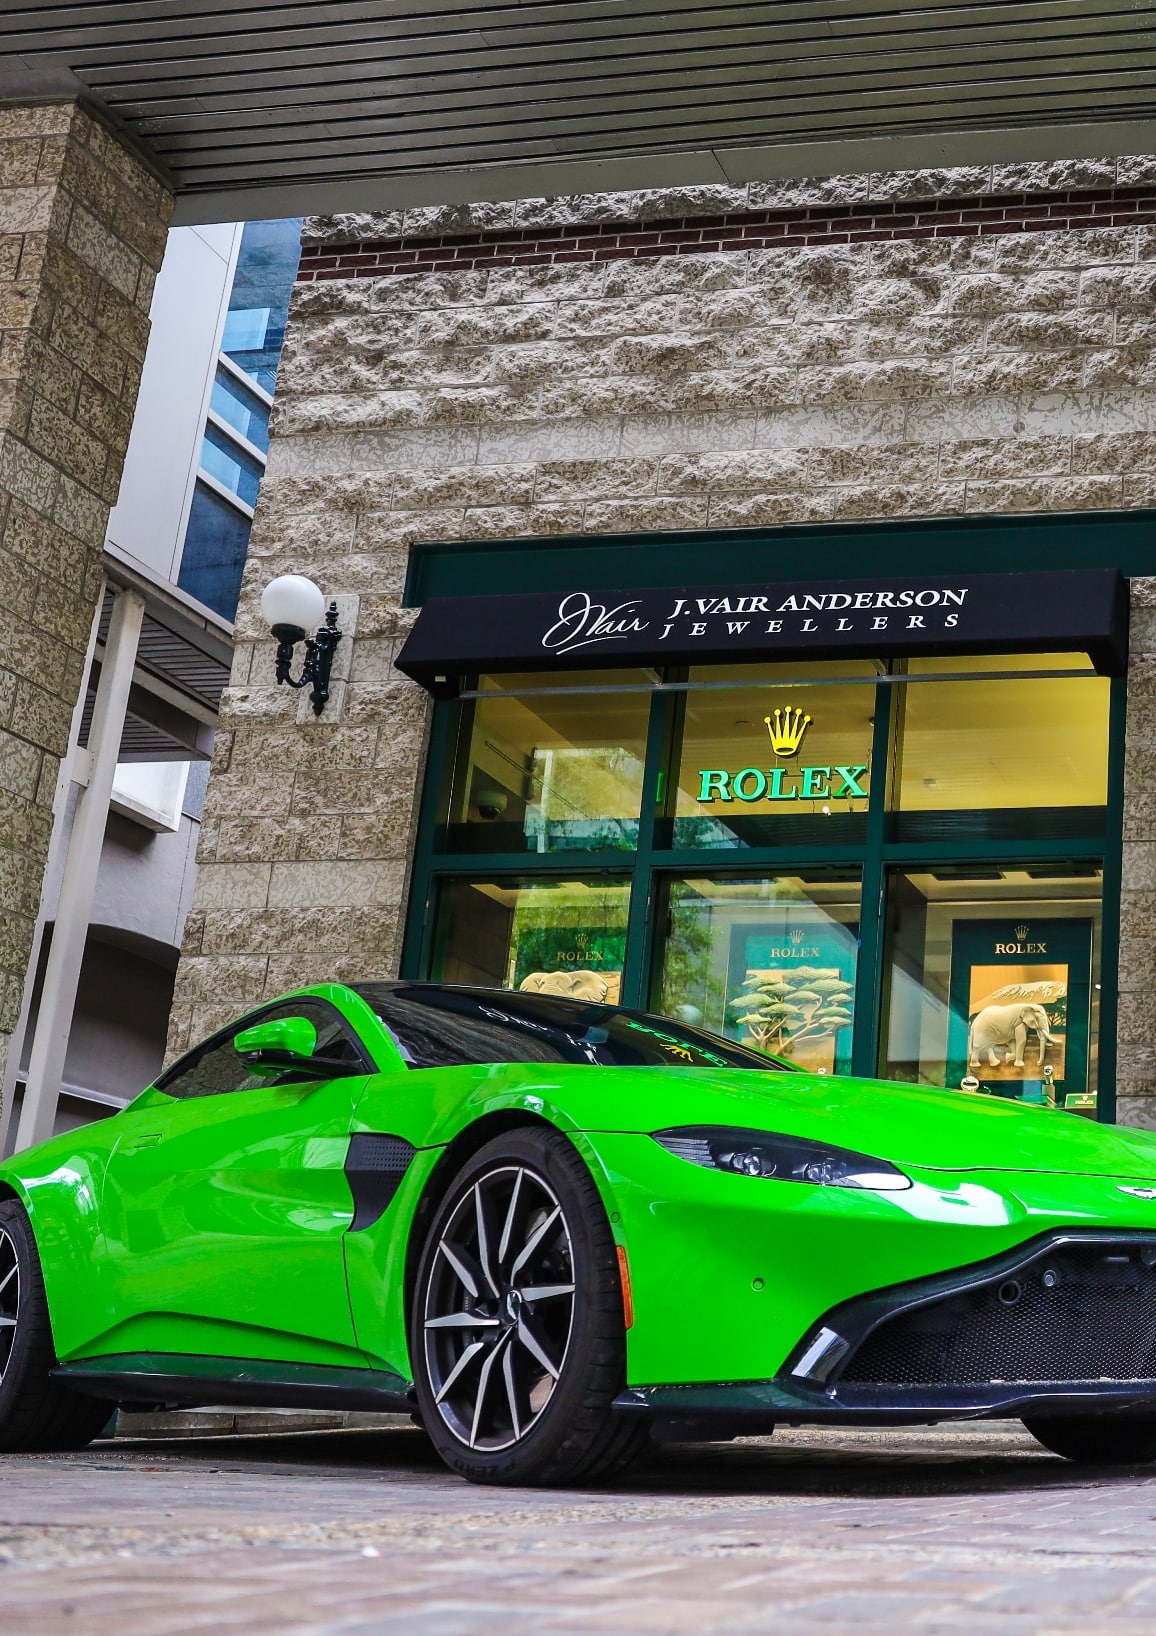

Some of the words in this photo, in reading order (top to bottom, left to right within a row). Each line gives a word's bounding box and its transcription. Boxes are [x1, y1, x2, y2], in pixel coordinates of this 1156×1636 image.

[667, 596, 771, 619] J.VAIR
[775, 588, 969, 613] ANDERSON
[658, 613, 959, 640] JEWELLERS
[697, 765, 868, 803] ROLEX
[556, 951, 604, 961] ROLEX
[770, 947, 821, 958] ROLEX
[994, 943, 1047, 954] ROLEX
[454, 1459, 499, 1477] ZERO
